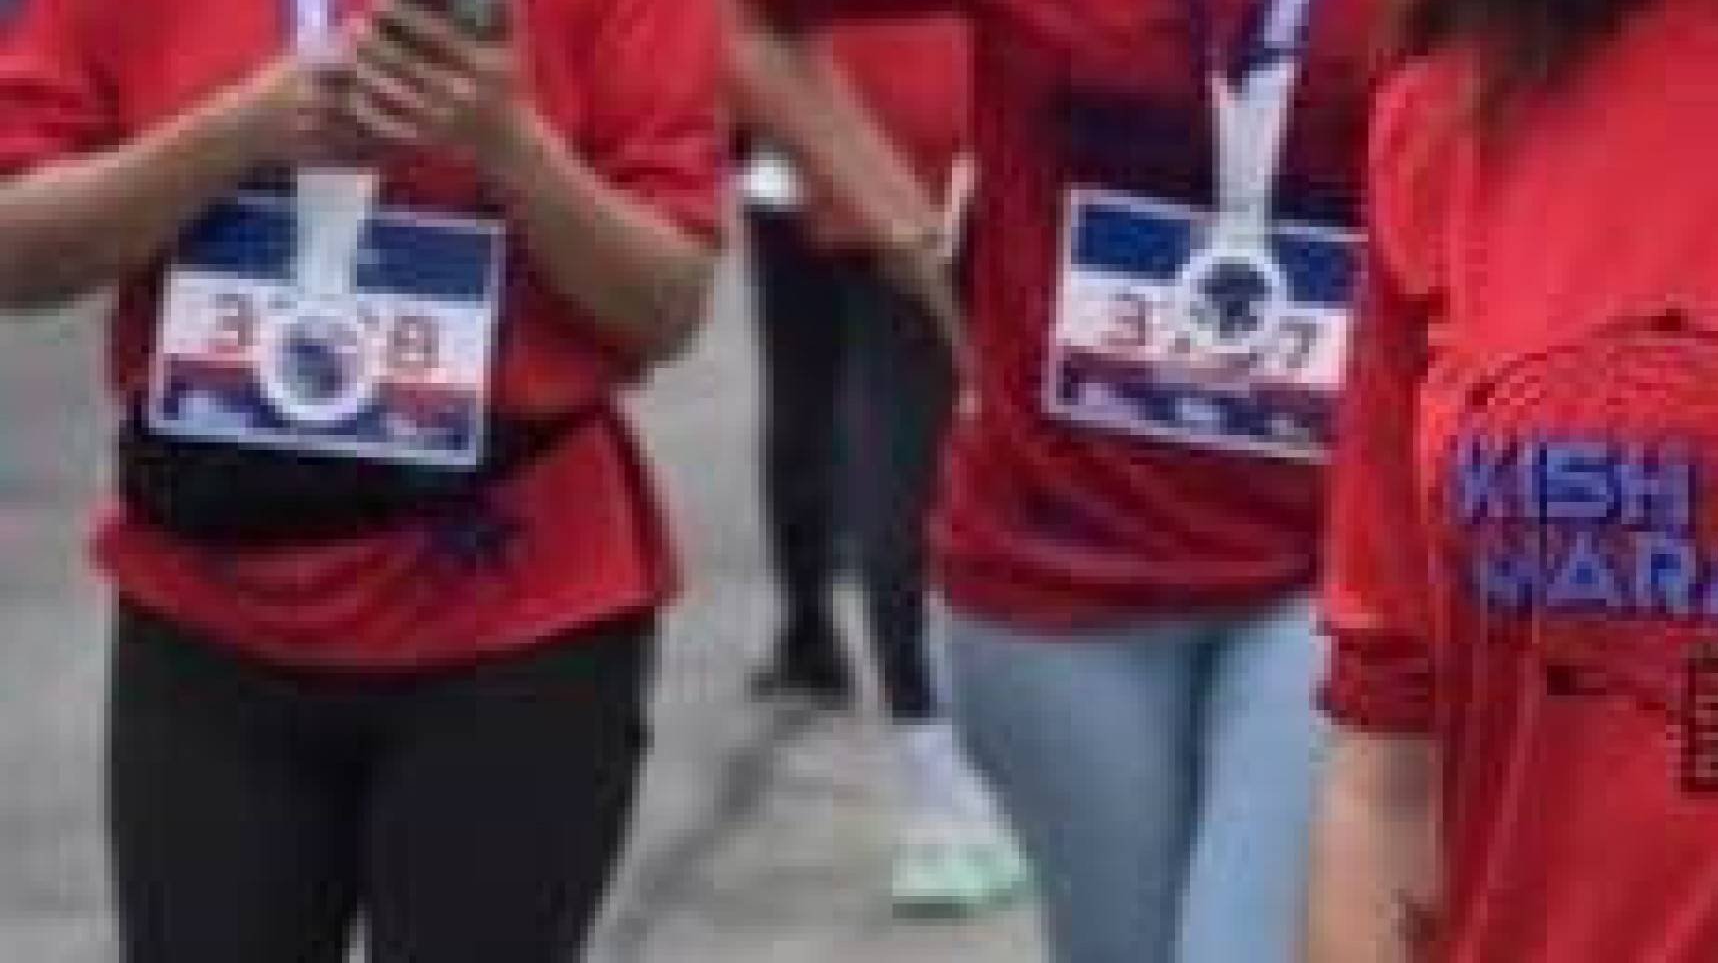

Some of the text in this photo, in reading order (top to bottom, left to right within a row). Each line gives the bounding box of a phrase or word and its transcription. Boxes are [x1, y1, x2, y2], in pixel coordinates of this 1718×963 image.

[209, 293, 439, 372] 38
[1101, 290, 1321, 369] 37
[1452, 436, 1693, 527] KISH
